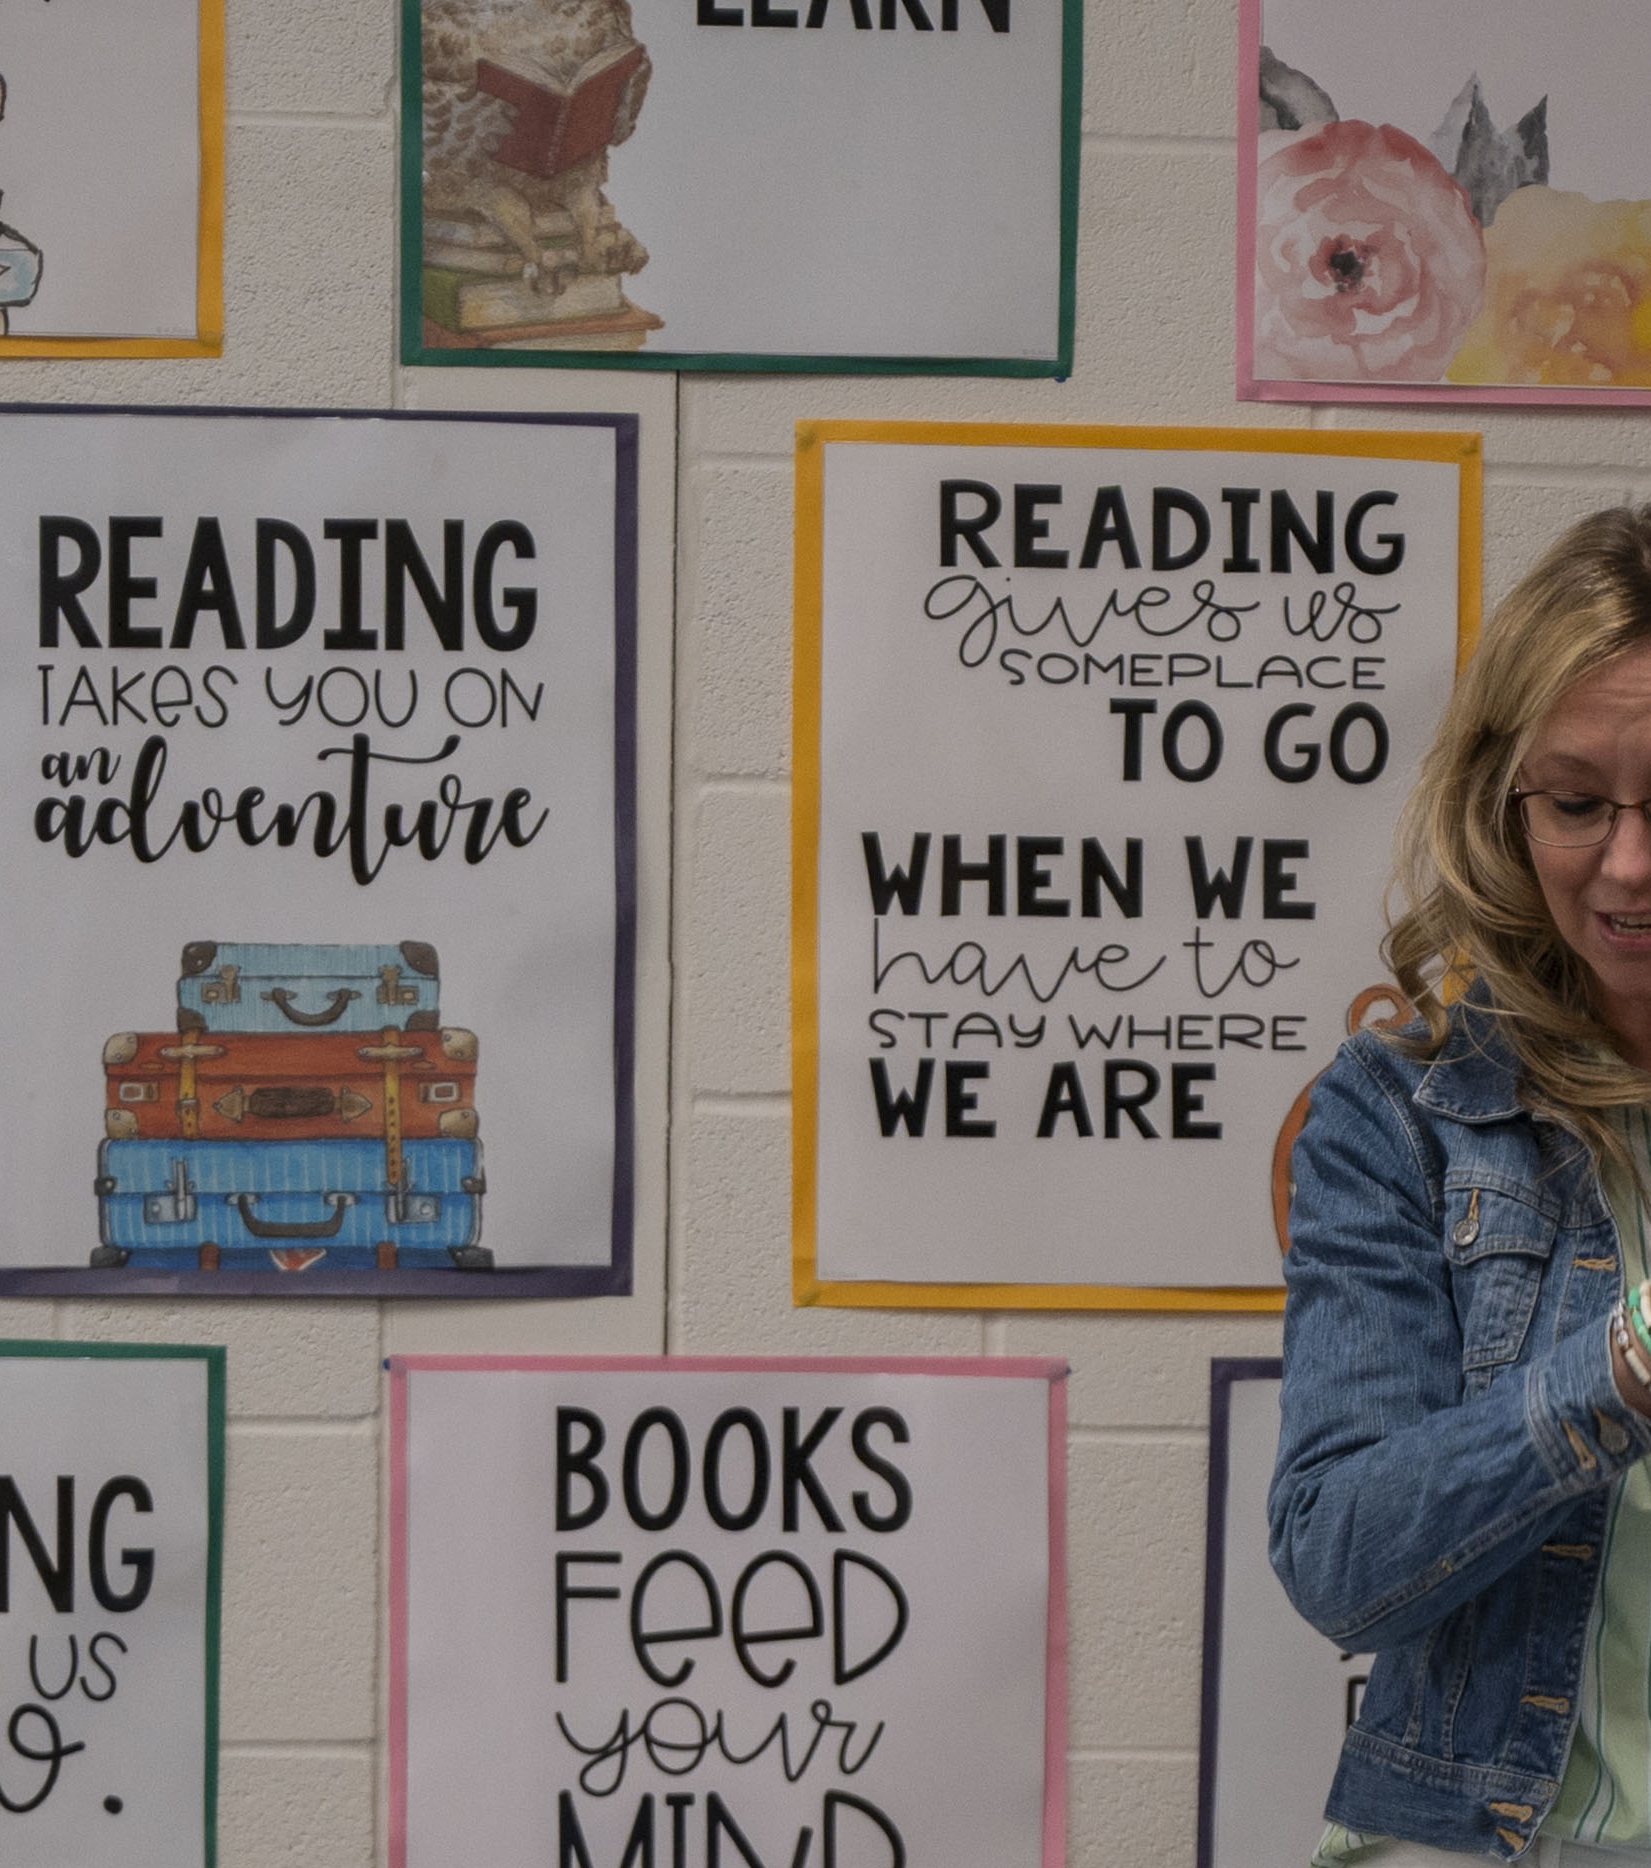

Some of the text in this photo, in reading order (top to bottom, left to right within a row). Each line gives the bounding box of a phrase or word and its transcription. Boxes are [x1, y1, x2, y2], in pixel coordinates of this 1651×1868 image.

[939, 479, 1405, 575] READING
[38, 515, 538, 652] READING
[924, 576, 1401, 667] gives us
[444, 667, 544, 729] ON
[1000, 650, 1386, 689] SOMEPLACE
[41, 746, 120, 787] an
[1109, 698, 1389, 784] TO GO
[34, 734, 548, 885] adventure
[861, 832, 1316, 920] WHEN WE
[872, 919, 1299, 1002] have to
[869, 1010, 1306, 1050] STAY WHERE
[868, 1057, 1222, 1139] WE ARE
[555, 1406, 914, 1533] BOOKS
[30, 1632, 128, 1702] US
[555, 1697, 886, 1797] your
